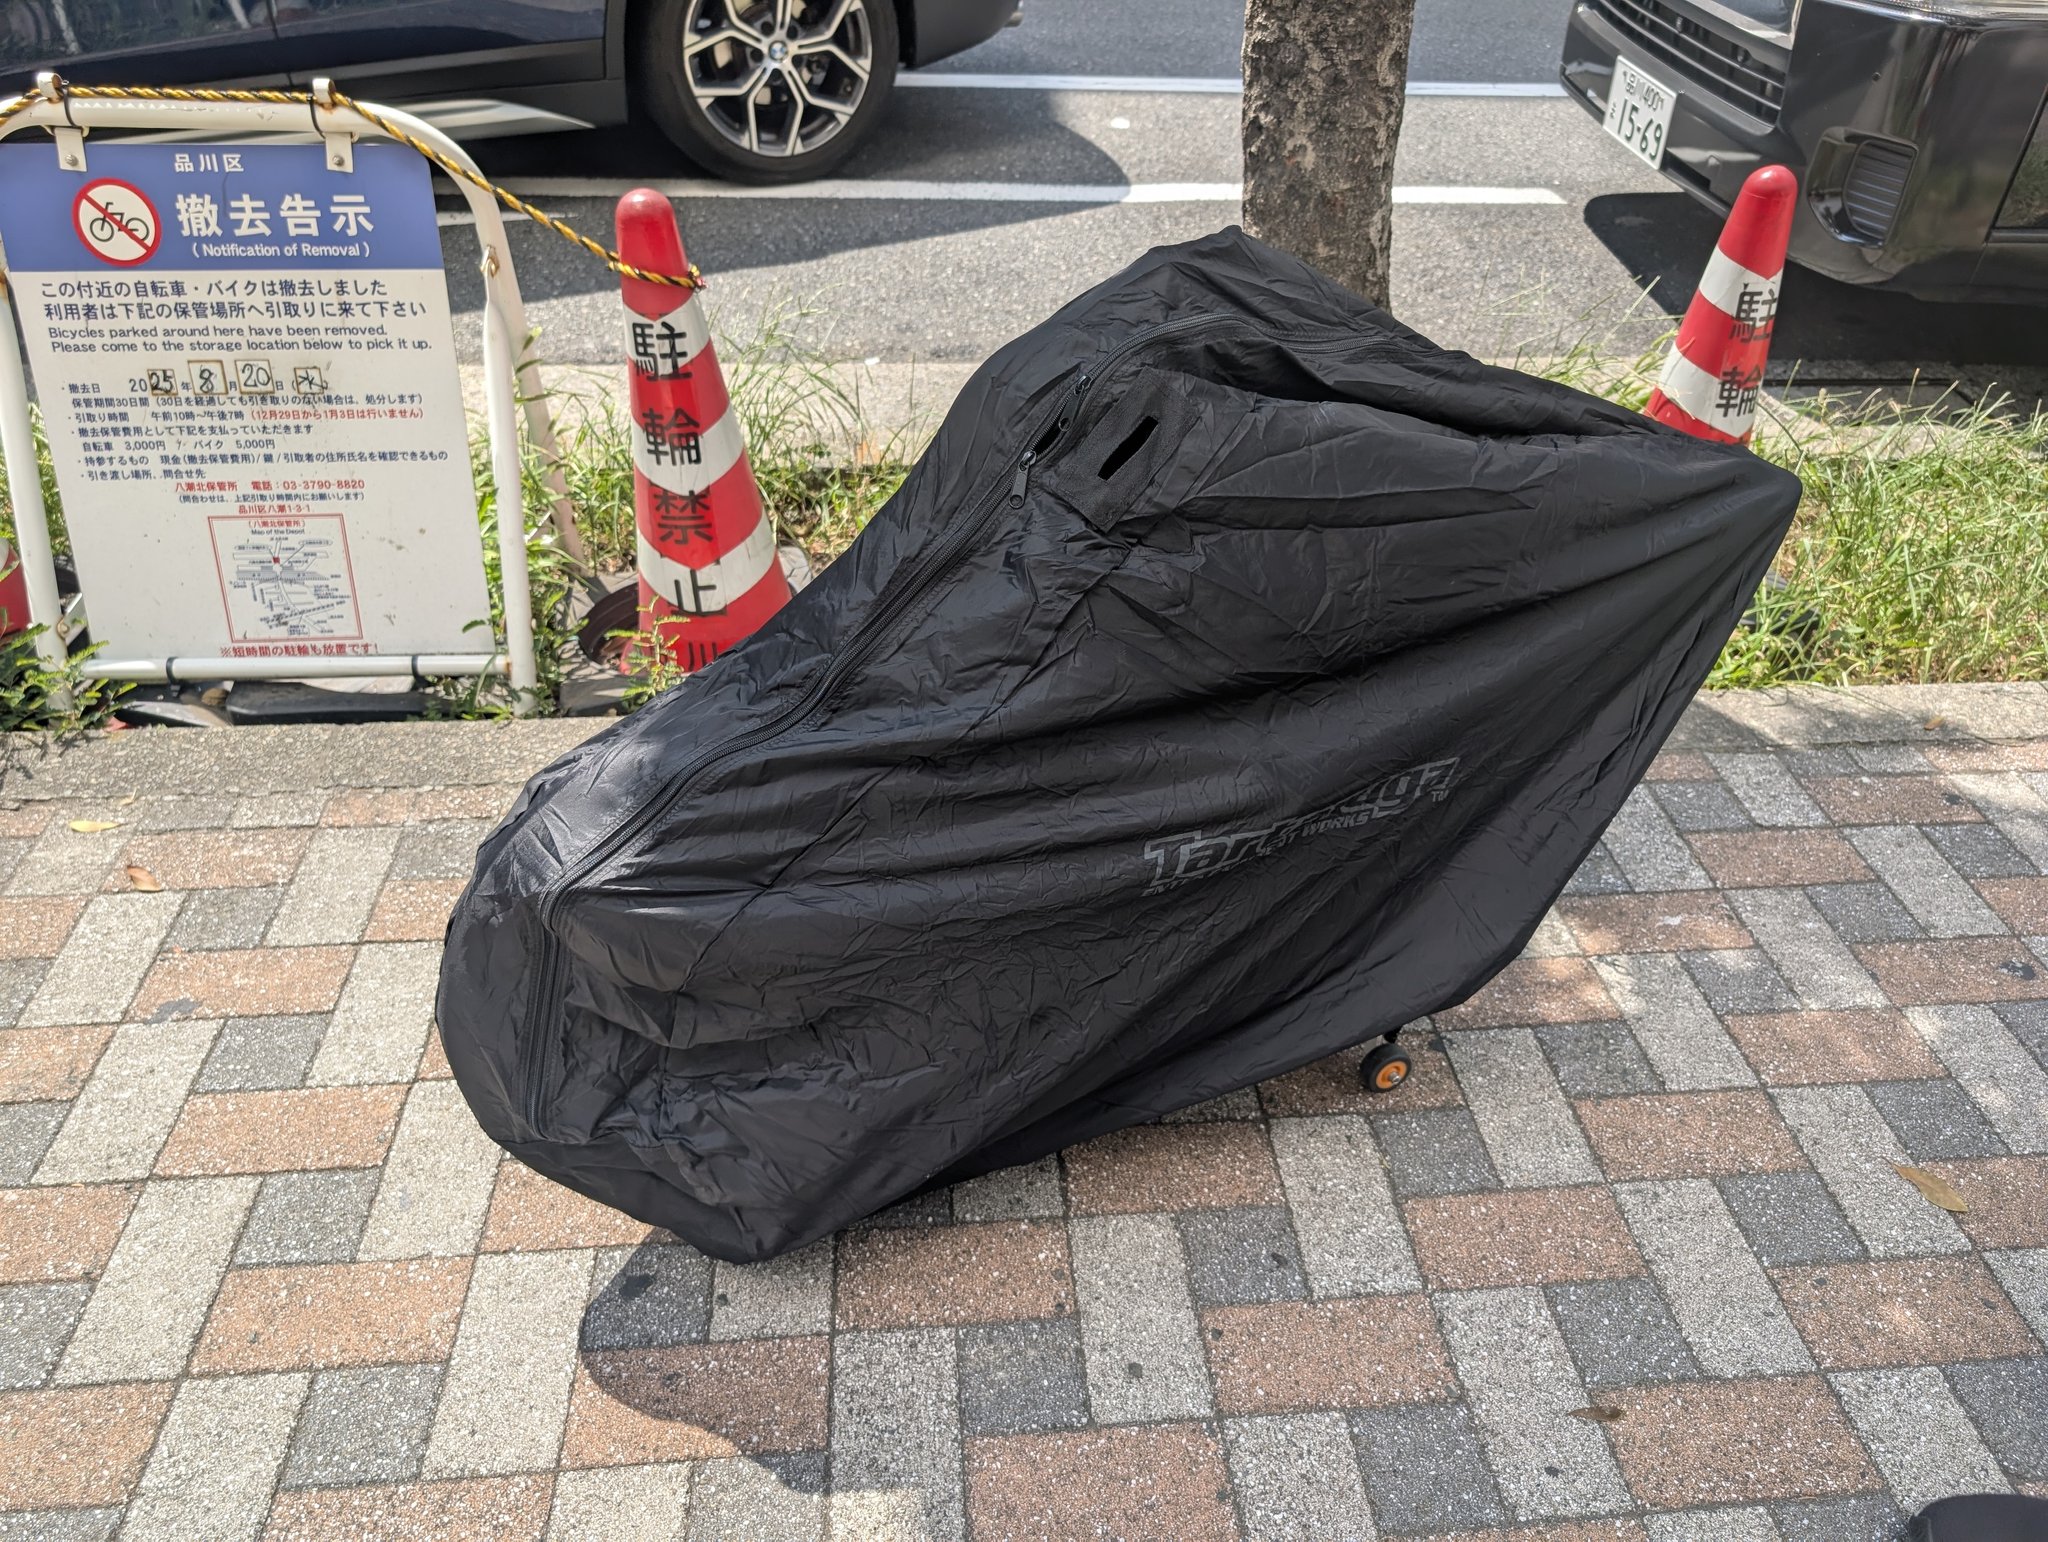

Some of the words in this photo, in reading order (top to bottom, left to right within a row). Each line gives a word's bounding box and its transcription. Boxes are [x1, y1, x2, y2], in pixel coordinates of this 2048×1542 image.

[1617, 98, 1664, 160] 15-69
[174, 153, 245, 173] 品川区
[176, 193, 375, 237] 撤去告示
[284, 243, 298, 257] of
[41, 279, 388, 299] この付近の自転車・バイクは撤去しました
[44, 301, 427, 321] 利用者は下記の保管場所へ引取りに来て下さい
[48, 327, 105, 339] Bicycles
[110, 326, 158, 339] parked
[163, 326, 210, 337] around
[213, 326, 244, 337] here
[248, 326, 282, 336] have
[286, 325, 321, 336] been
[325, 324, 388, 336] removed.
[52, 341, 97, 352] Please
[102, 343, 138, 352] come
[143, 341, 158, 351] to
[162, 341, 184, 351] the
[189, 341, 242, 353] storage
[247, 339, 300, 350] location
[303, 339, 343, 350] below
[349, 339, 363, 349] to
[367, 338, 394, 350] pick
[398, 338, 408, 349] it
[412, 339, 432, 351] up.
[82, 441, 114, 452] 自転車
[124, 440, 167, 451] 3,000円
[194, 439, 225, 450] バイク
[235, 438, 276, 450] 5,000円
[1301, 810, 1371, 837] WORKS
